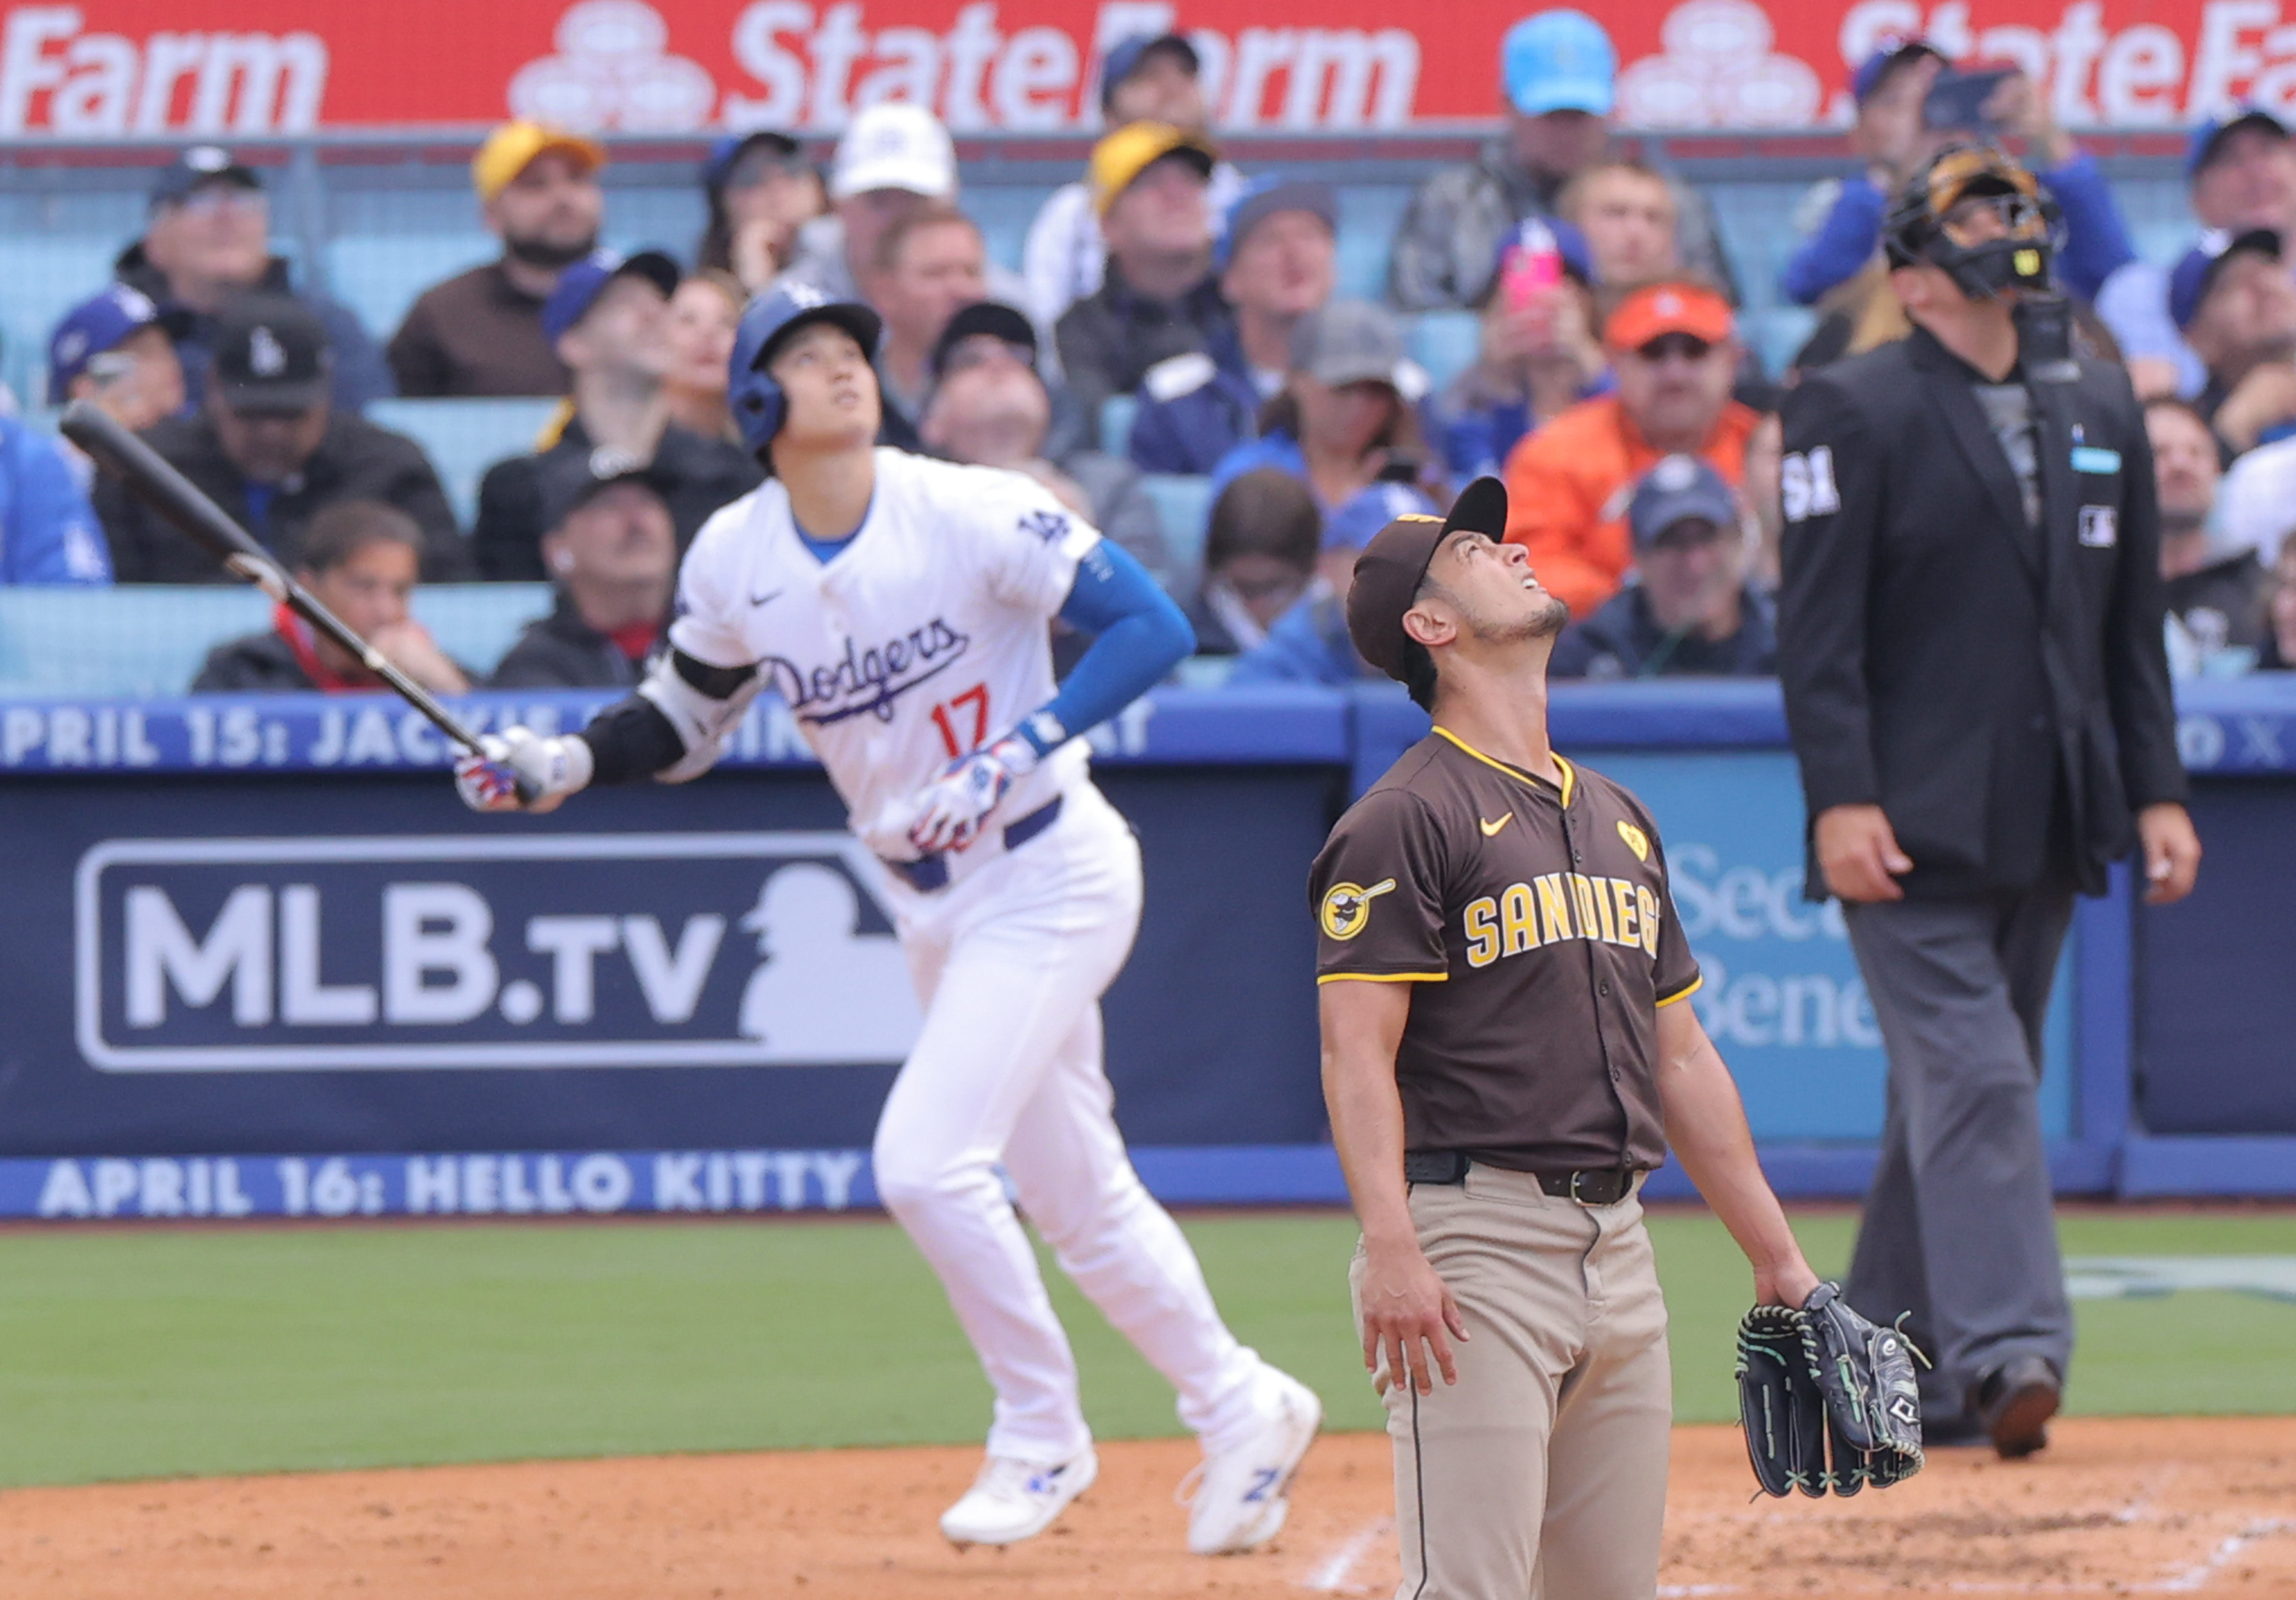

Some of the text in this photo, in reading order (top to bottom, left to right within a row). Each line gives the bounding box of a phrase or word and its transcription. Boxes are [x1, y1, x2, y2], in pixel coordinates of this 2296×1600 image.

[1, 5, 328, 136] Farm
[723, 0, 1080, 131] State
[757, 618, 969, 723] Dodgers
[932, 682, 990, 757] 17
[186, 705, 288, 766] 15:
[124, 884, 726, 1027] MLB.TV
[1463, 871, 1661, 968] SAN DIEG
[37, 1150, 862, 1219] APRIL 16: HELLO KITTY
